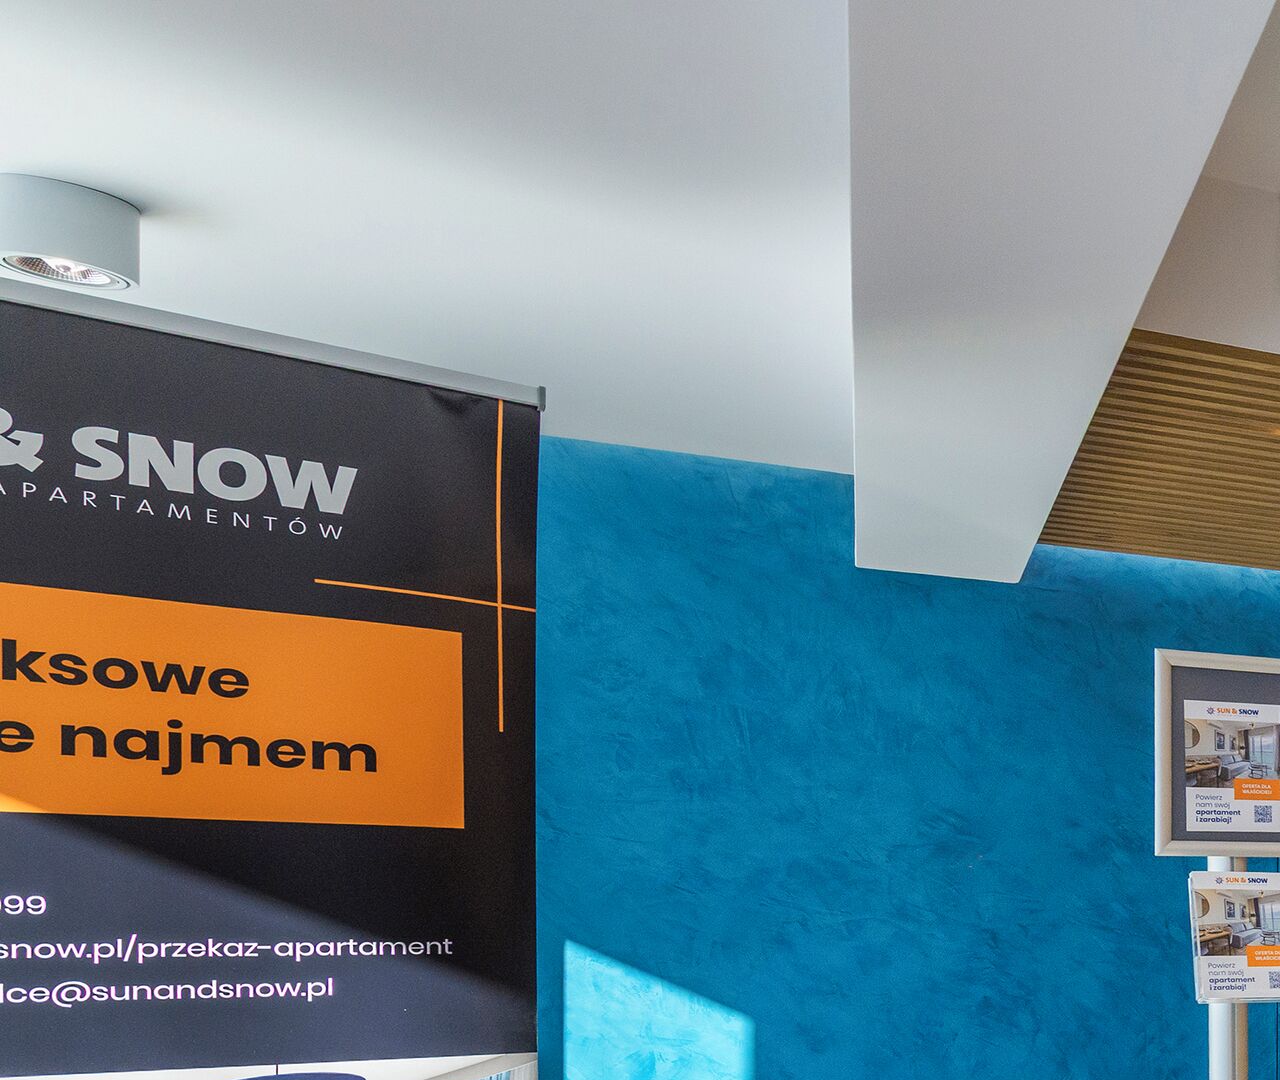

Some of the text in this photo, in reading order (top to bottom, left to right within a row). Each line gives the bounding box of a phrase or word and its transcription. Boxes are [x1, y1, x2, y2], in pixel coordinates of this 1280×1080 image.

[72, 427, 358, 515] SNOW
[2, 638, 249, 698] ksowe
[61, 720, 377, 775] najmem
[1214, 801, 1230, 809] swój
[0, 894, 47, 915] 99
[1227, 969, 1244, 977] swój
